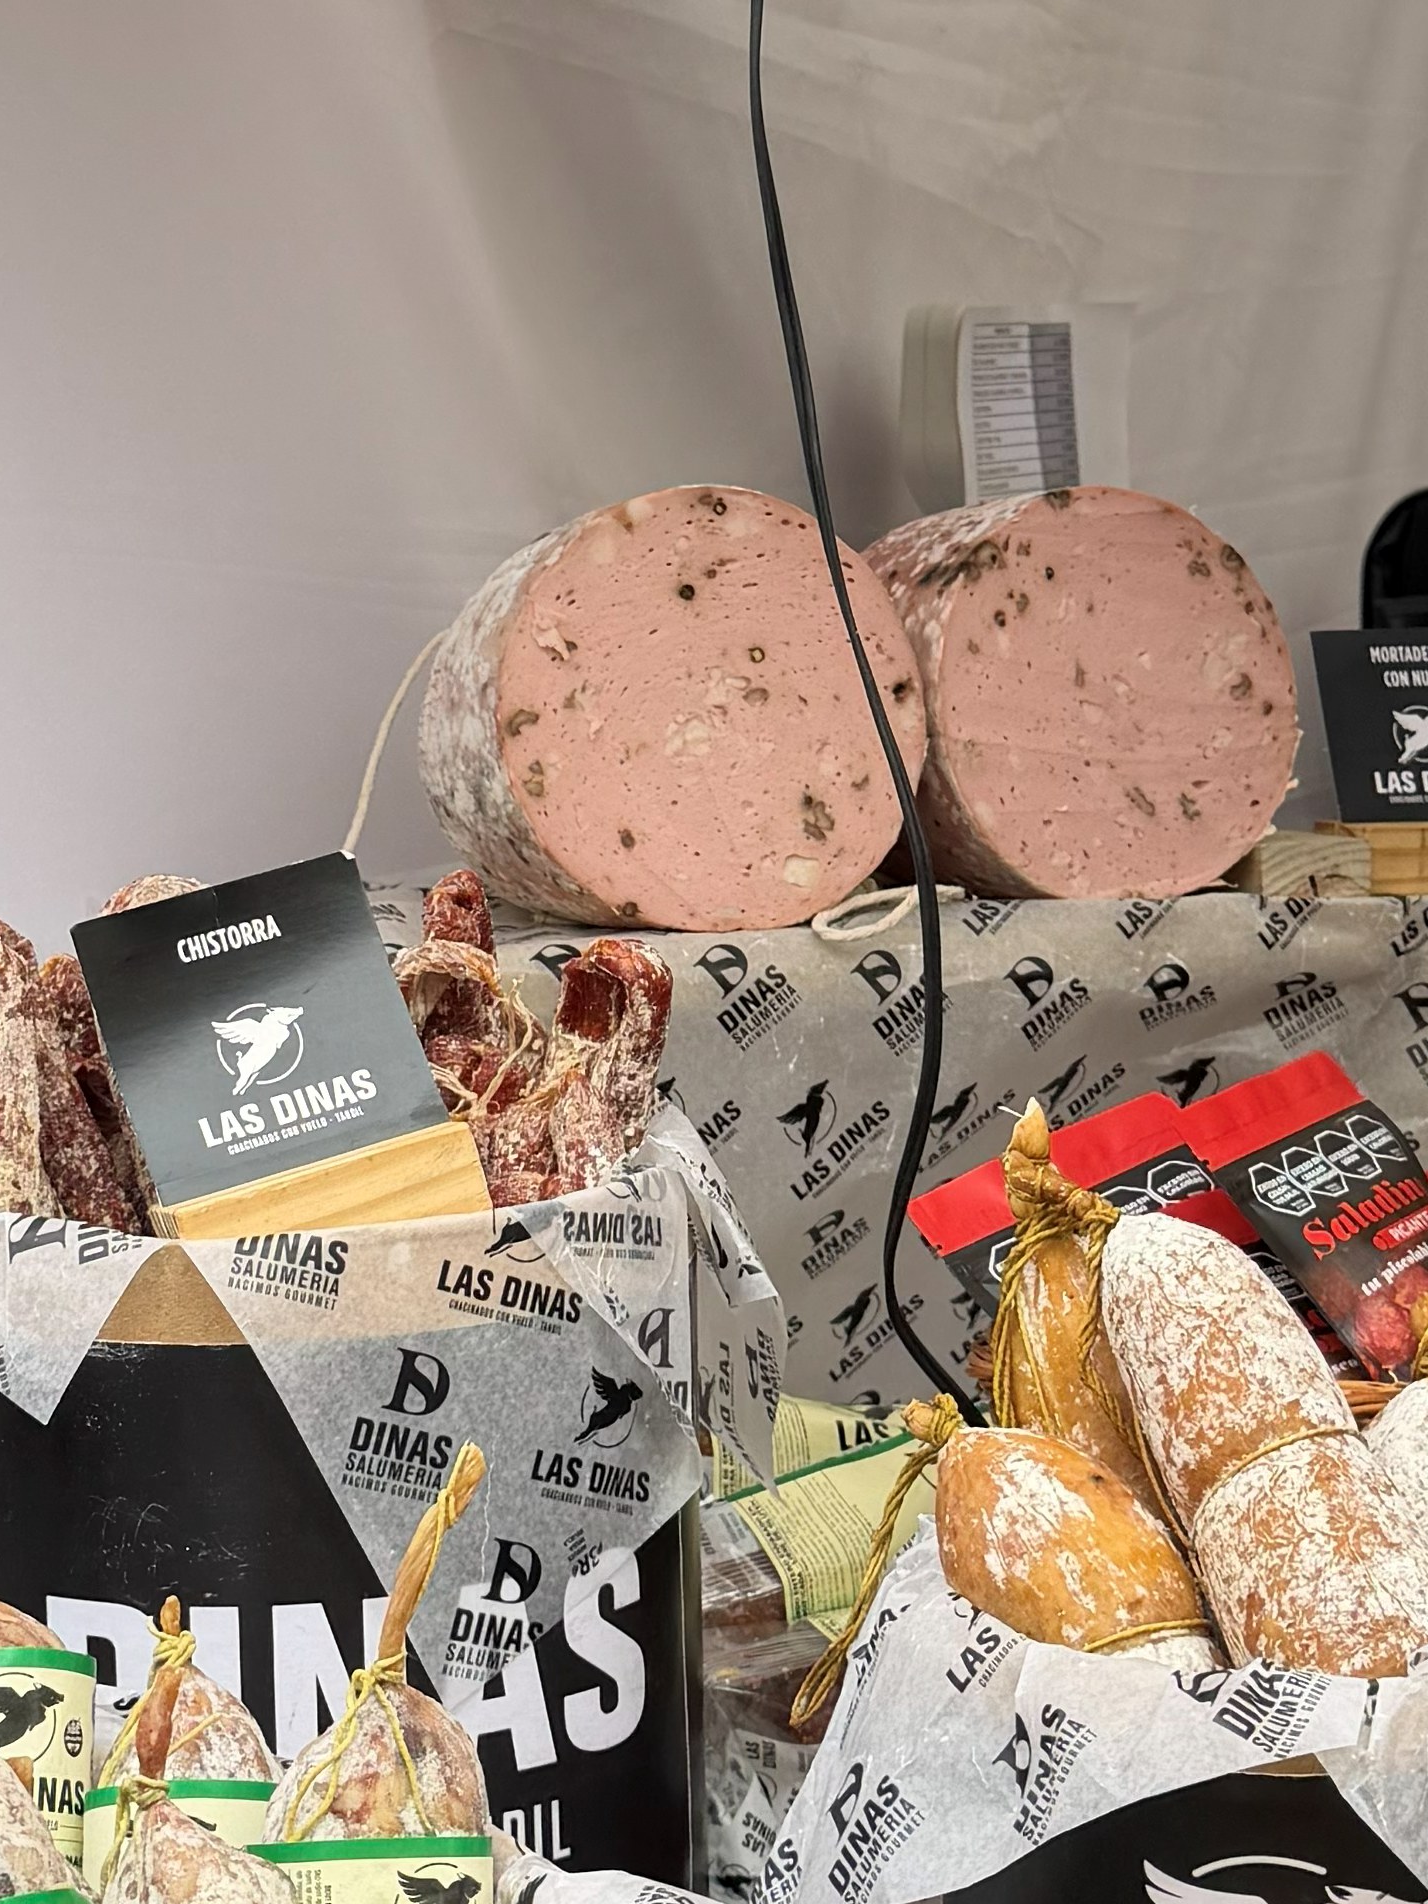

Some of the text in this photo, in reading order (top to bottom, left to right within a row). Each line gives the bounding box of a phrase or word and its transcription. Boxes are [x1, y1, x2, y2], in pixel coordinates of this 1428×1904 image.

[1383, 671, 1410, 687] CON
[1374, 771, 1417, 794] LAS
[177, 915, 282, 963] CHISTORRA
[717, 965, 788, 1034] DINAS
[1021, 978, 1089, 1042] DINAS
[1264, 981, 1337, 1029] DINAS
[198, 1069, 377, 1148] LAS DINAS
[699, 1100, 741, 1147] NAS
[790, 1100, 891, 1201] LAS DINAS
[230, 1256, 340, 1298] SALUMERIA
[436, 1258, 584, 1325] LAS DINAS
[345, 1451, 443, 1490] SALUMERIA
[349, 1416, 453, 1471] DINAS
[531, 1448, 651, 1504] LAS DINAS
[945, 1626, 1001, 1694] LAS
[38, 1777, 84, 1816] NAS
[828, 1775, 901, 1897] DINAS
